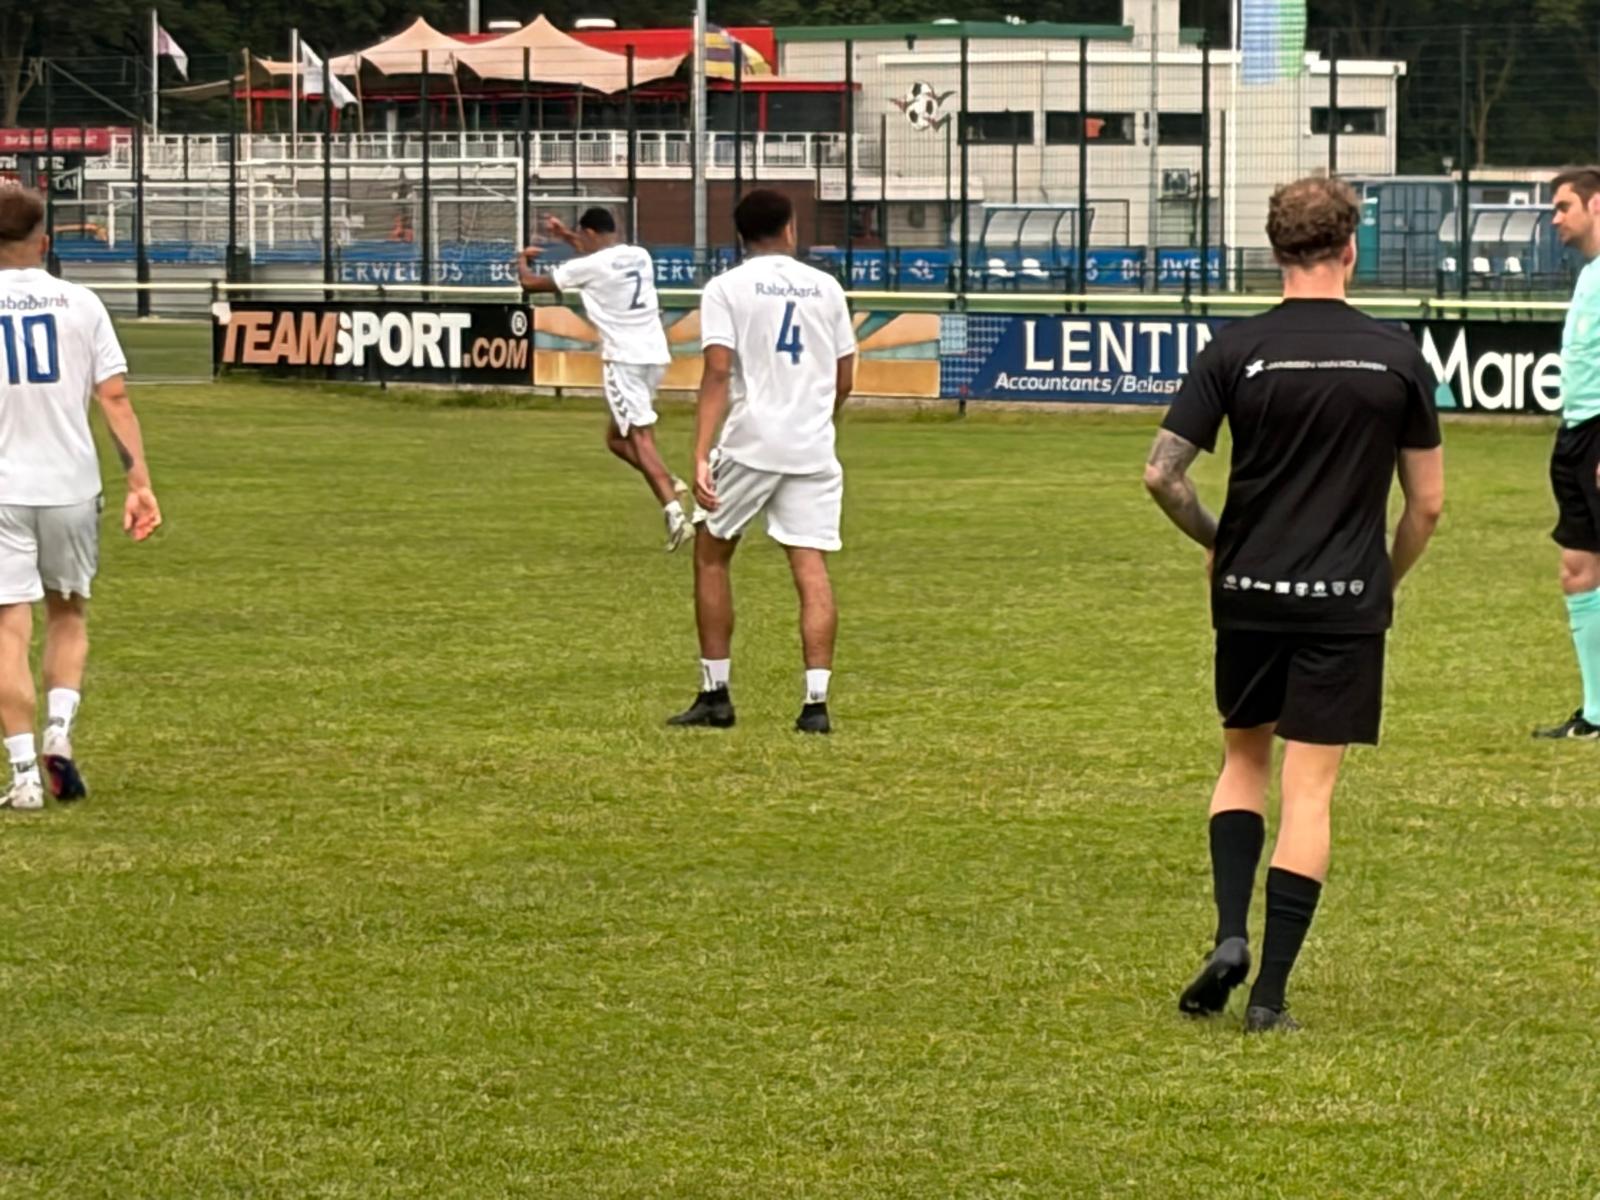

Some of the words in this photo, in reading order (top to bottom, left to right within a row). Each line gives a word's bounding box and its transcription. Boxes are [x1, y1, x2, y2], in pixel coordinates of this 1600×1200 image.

[625, 270, 647, 310] 2
[0, 313, 60, 385] 10
[775, 301, 804, 365] 4
